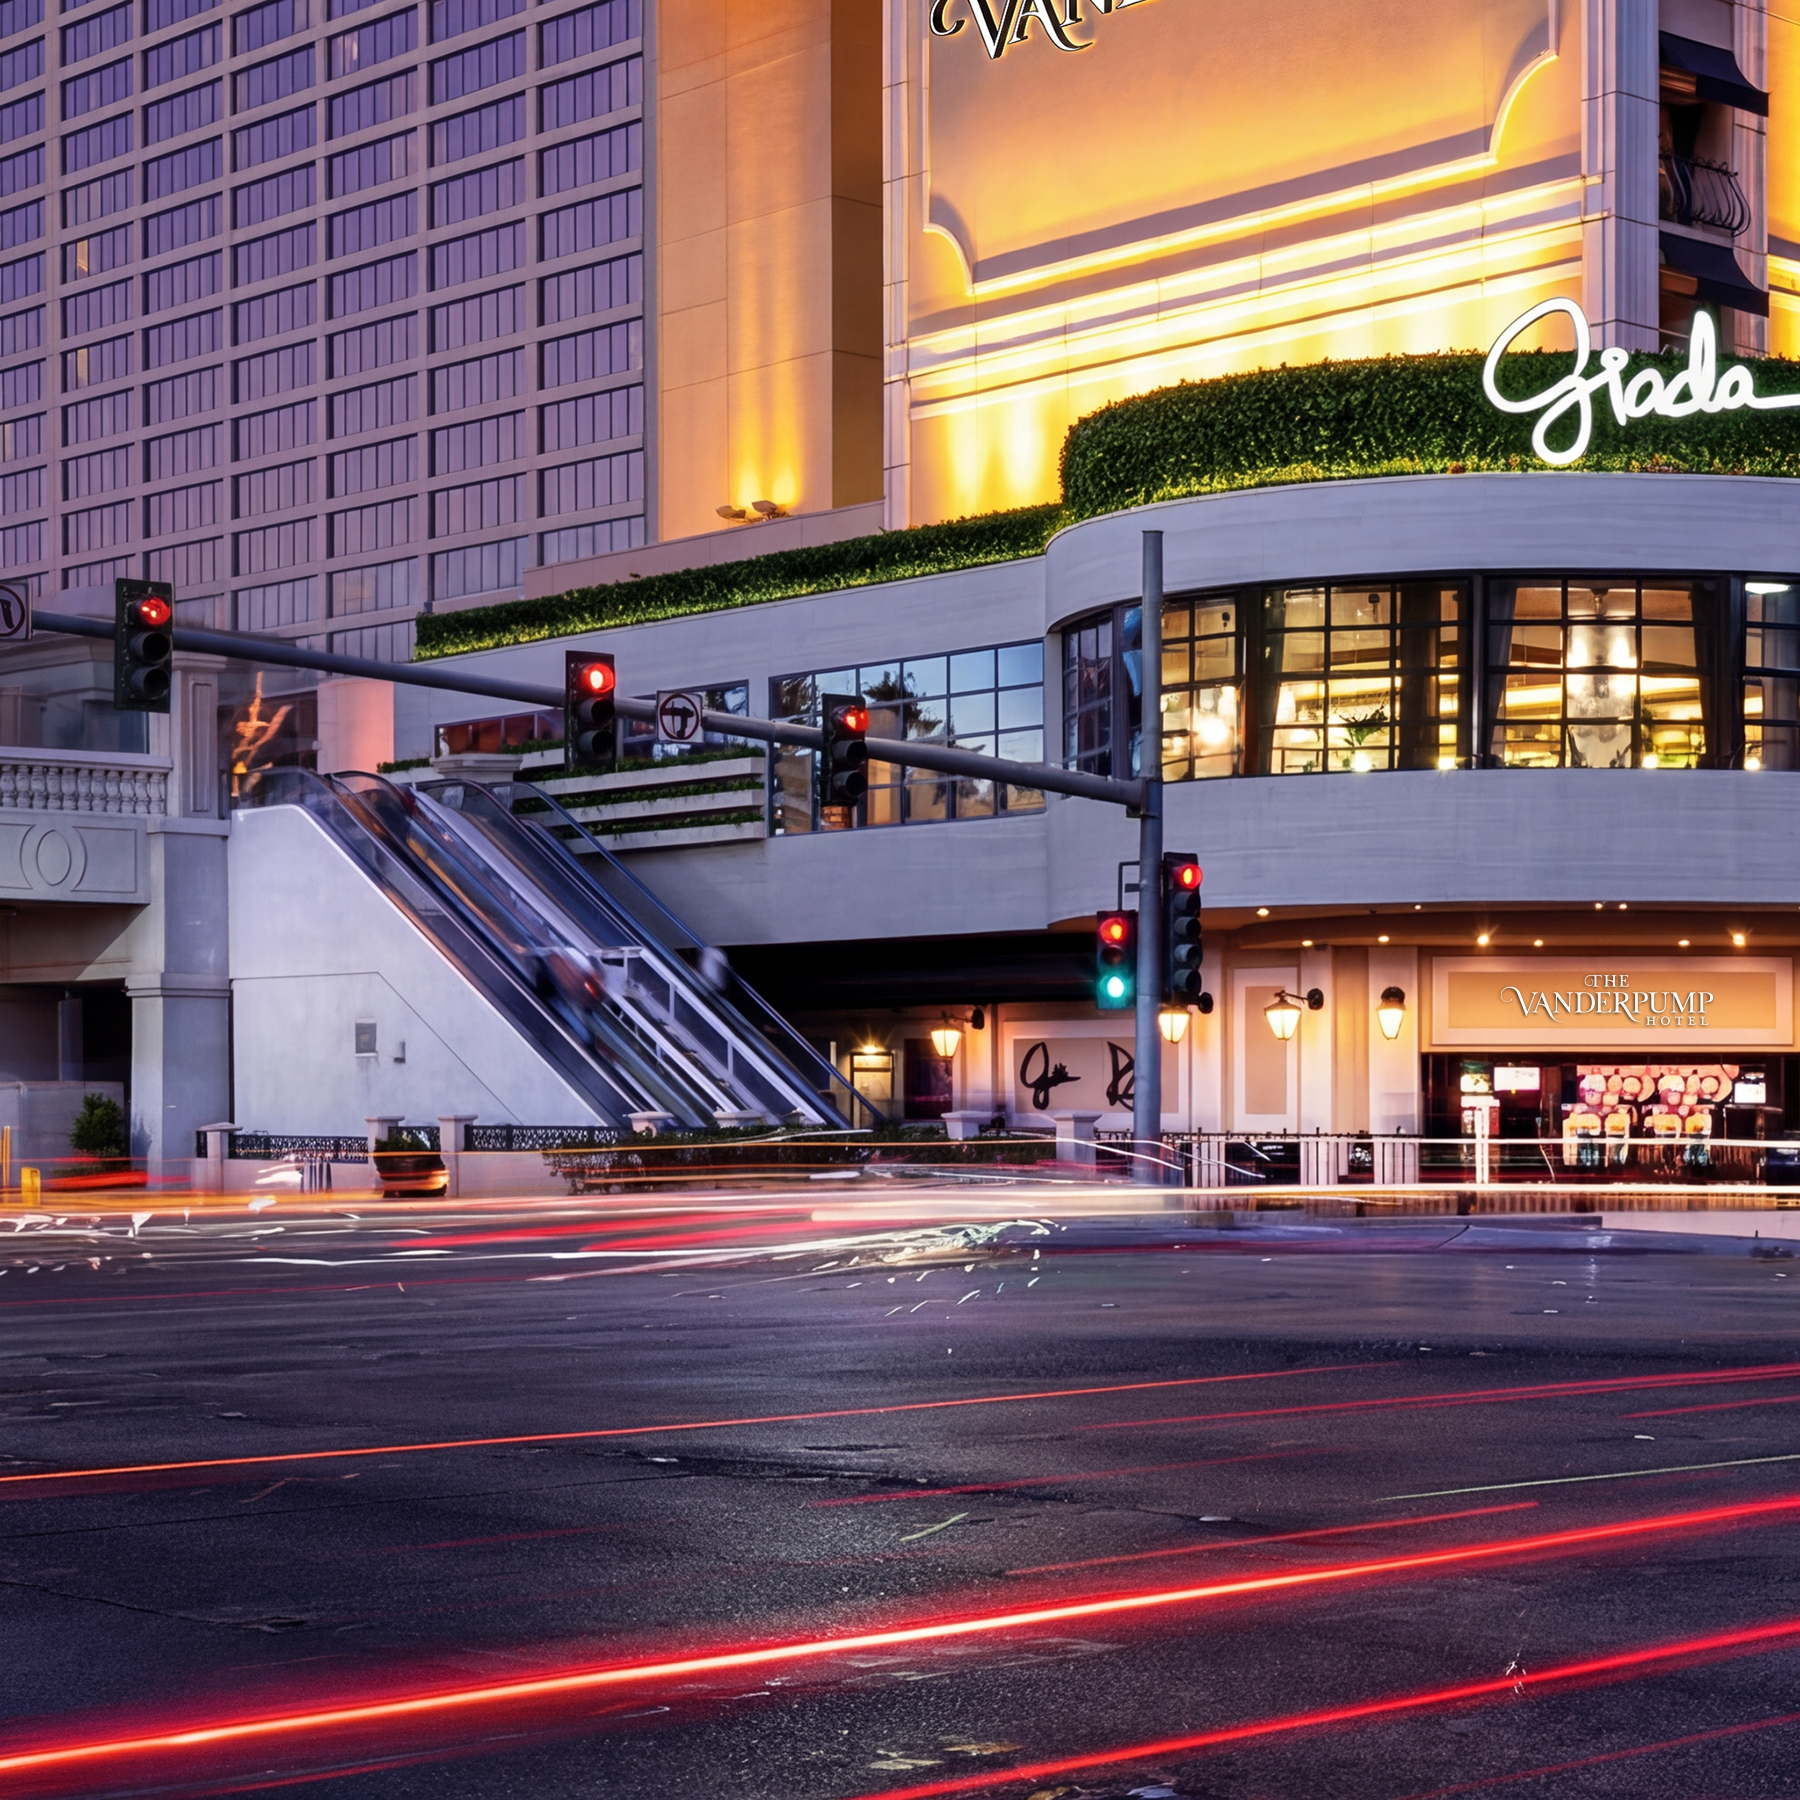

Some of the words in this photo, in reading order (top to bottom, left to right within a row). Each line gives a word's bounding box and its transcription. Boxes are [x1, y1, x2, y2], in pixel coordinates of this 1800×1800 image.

[1584, 974, 1629, 987] THE
[1500, 986, 1714, 1022] VANDERPUMP
[1646, 1015, 1709, 1026] HOTEL
